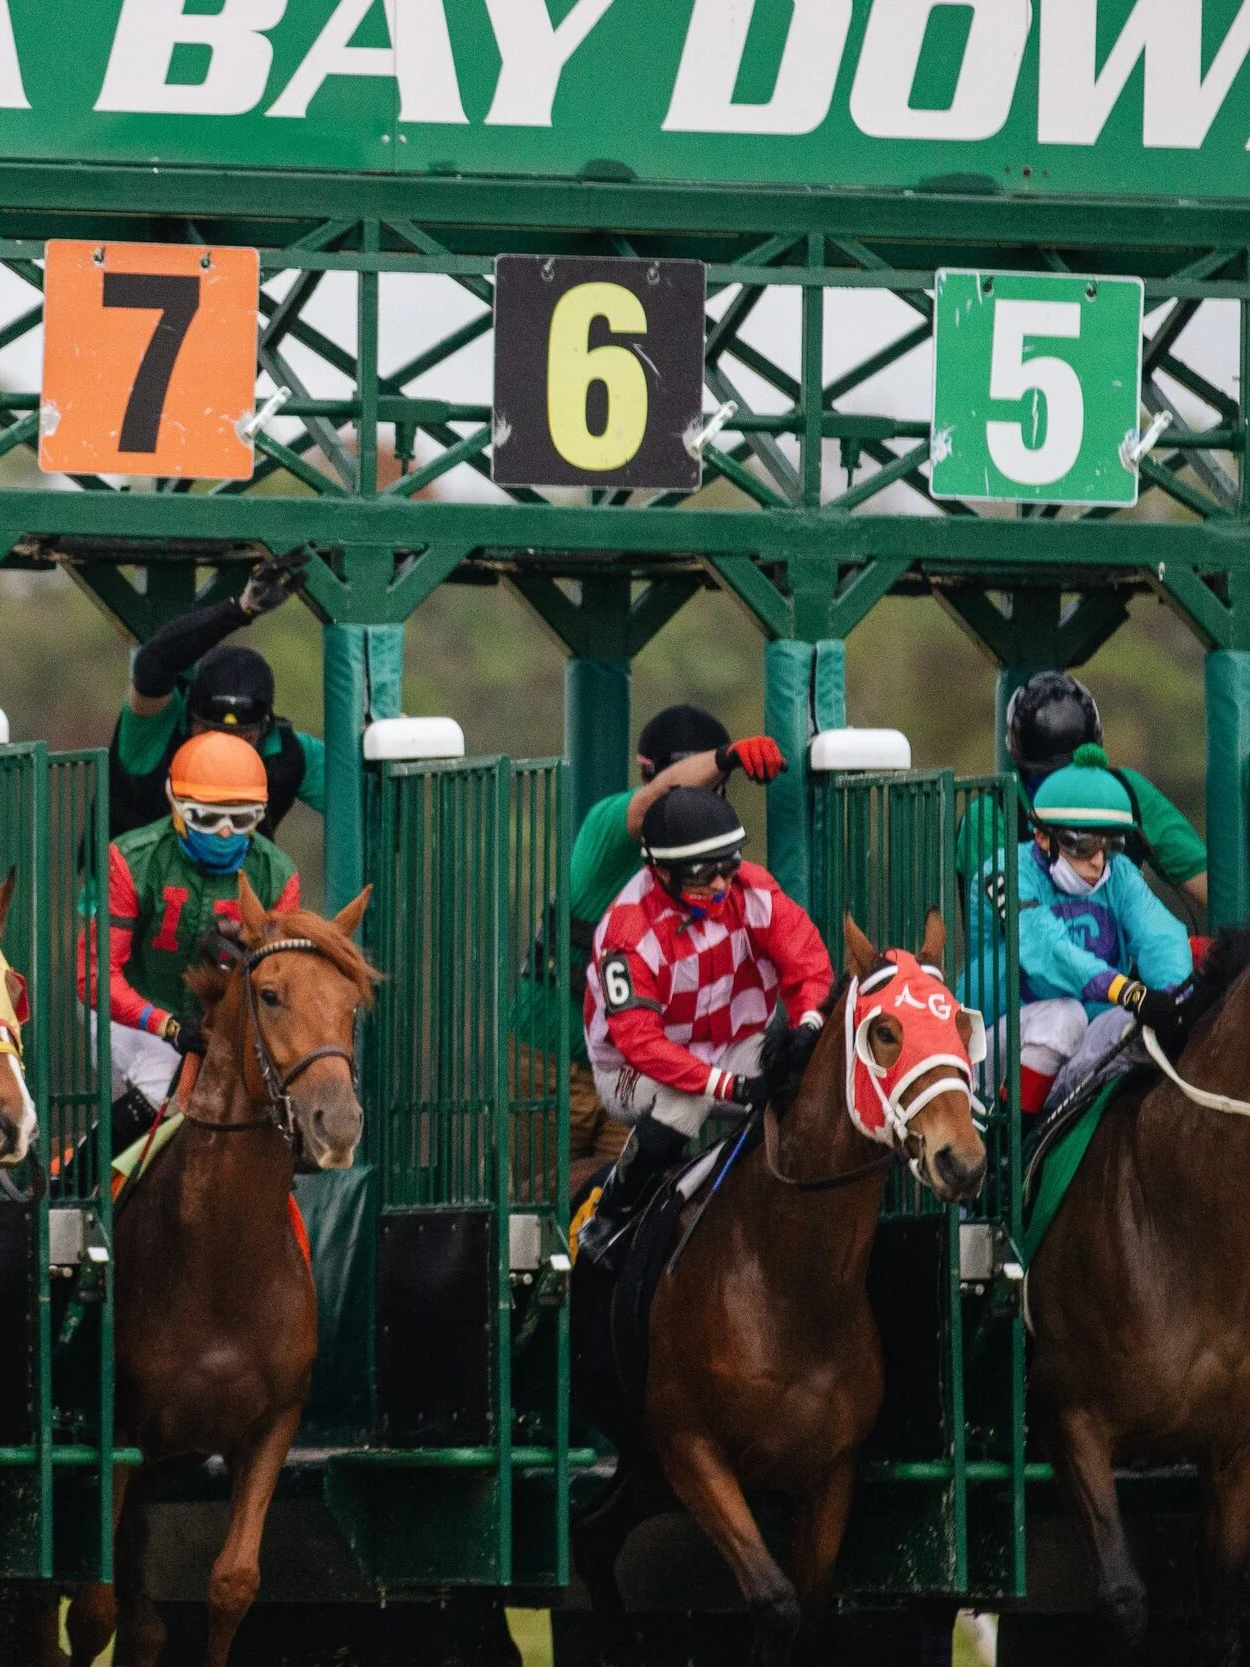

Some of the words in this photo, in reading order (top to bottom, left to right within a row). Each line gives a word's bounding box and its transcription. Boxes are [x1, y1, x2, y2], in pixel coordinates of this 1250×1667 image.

[92, 0, 617, 127] BAY
[661, 0, 1250, 150] DOW
[102, 272, 201, 454] 7
[547, 282, 649, 472] 6
[985, 299, 1085, 486] 5
[605, 960, 630, 1006] 6
